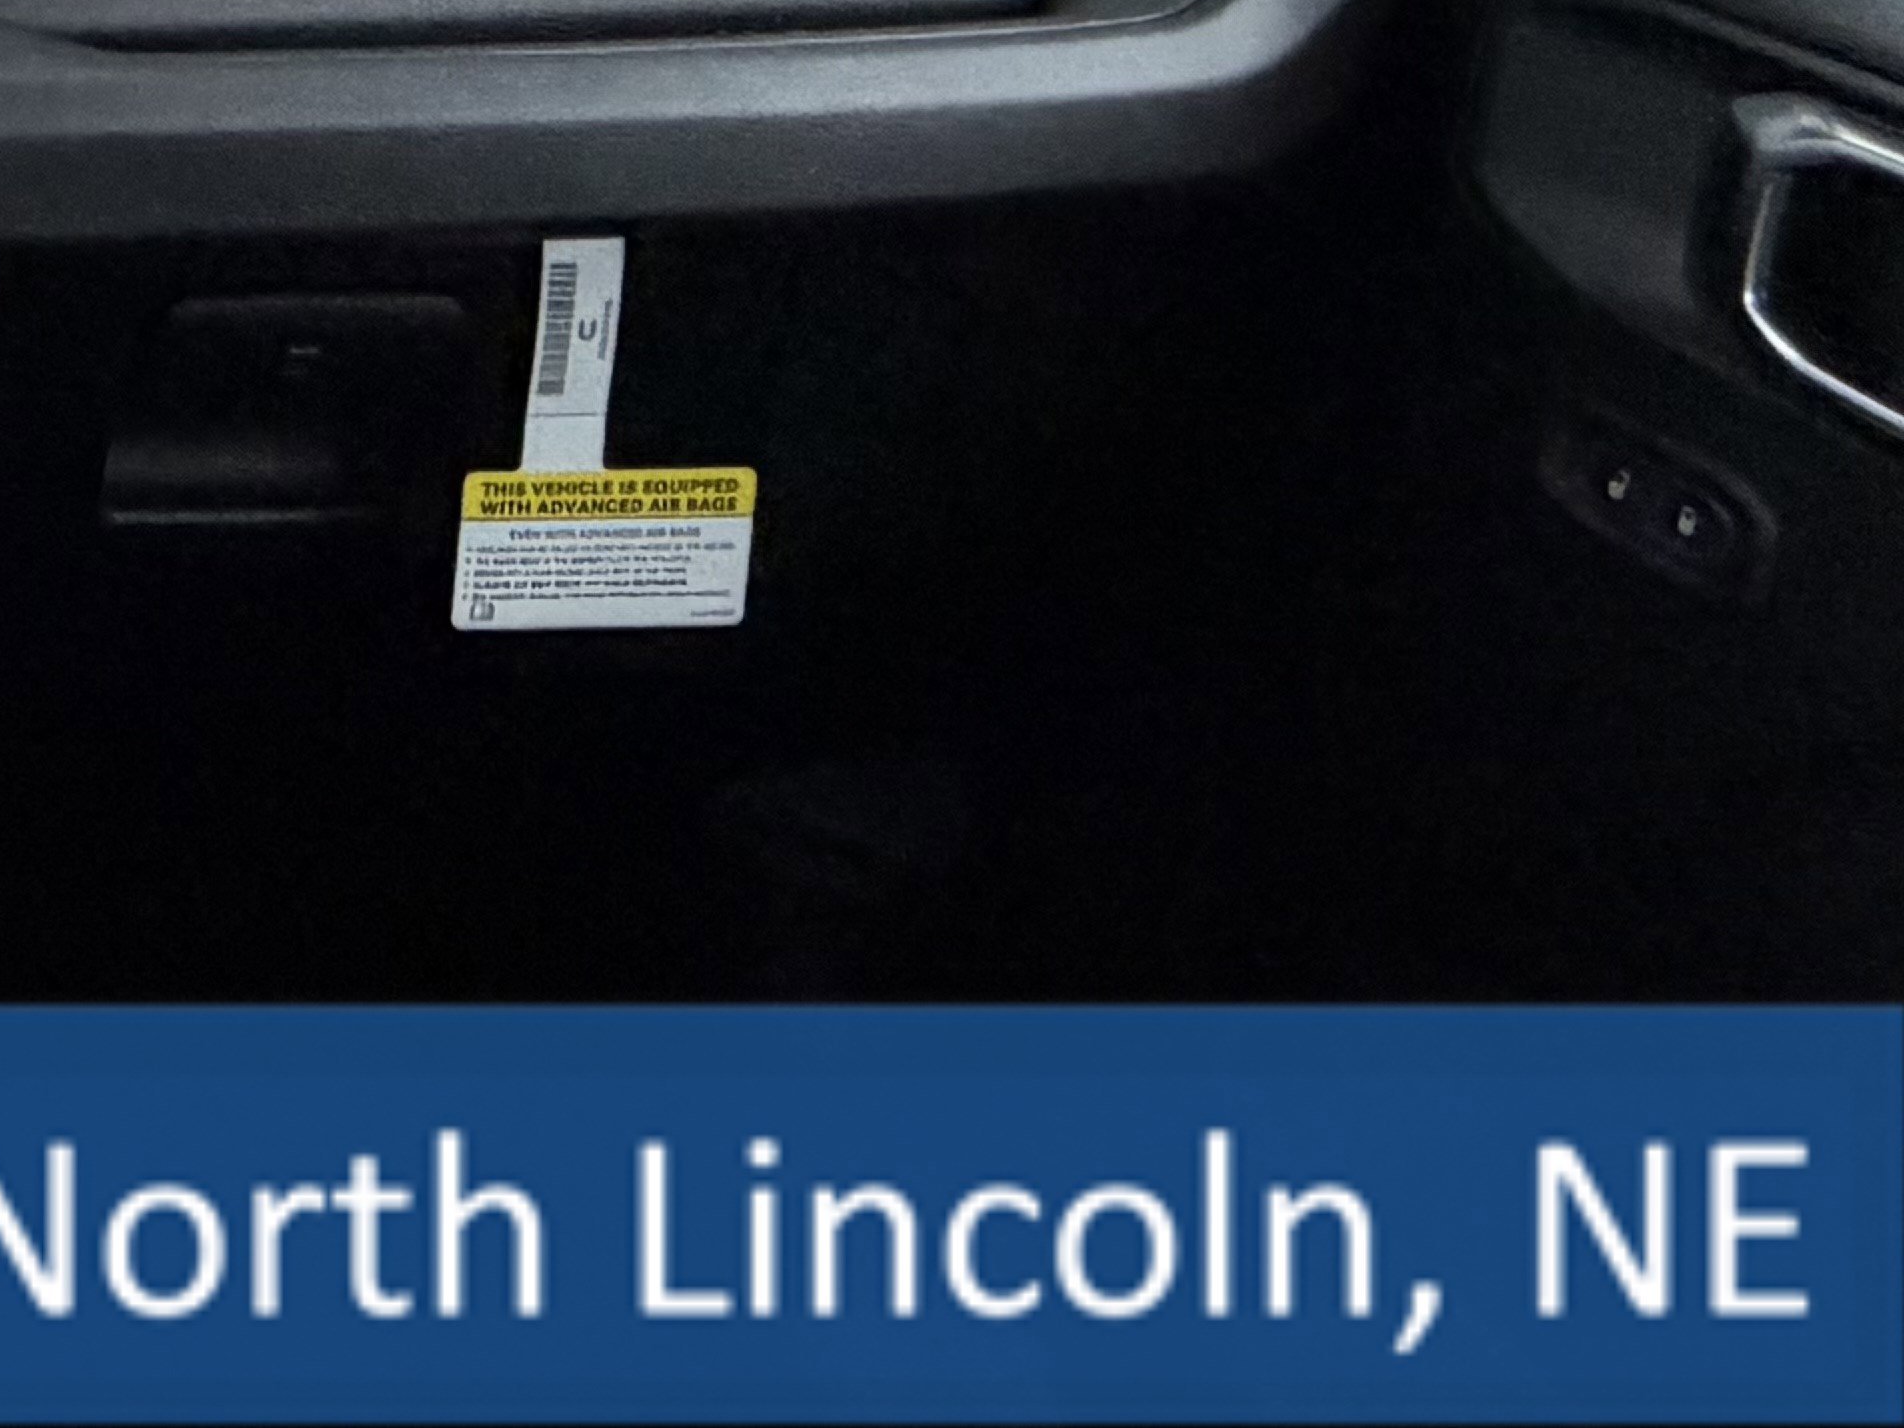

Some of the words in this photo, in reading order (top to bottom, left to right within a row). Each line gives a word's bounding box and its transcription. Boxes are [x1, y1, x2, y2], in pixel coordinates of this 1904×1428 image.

[481, 482, 527, 498] THIS
[531, 481, 614, 496] VEHICLE
[619, 480, 638, 495] IS
[643, 478, 740, 494] EQUIPPED
[480, 499, 531, 514] WITH
[536, 498, 643, 514] ADVANCED
[648, 498, 682, 512] AIR
[686, 497, 738, 512] BAGS
